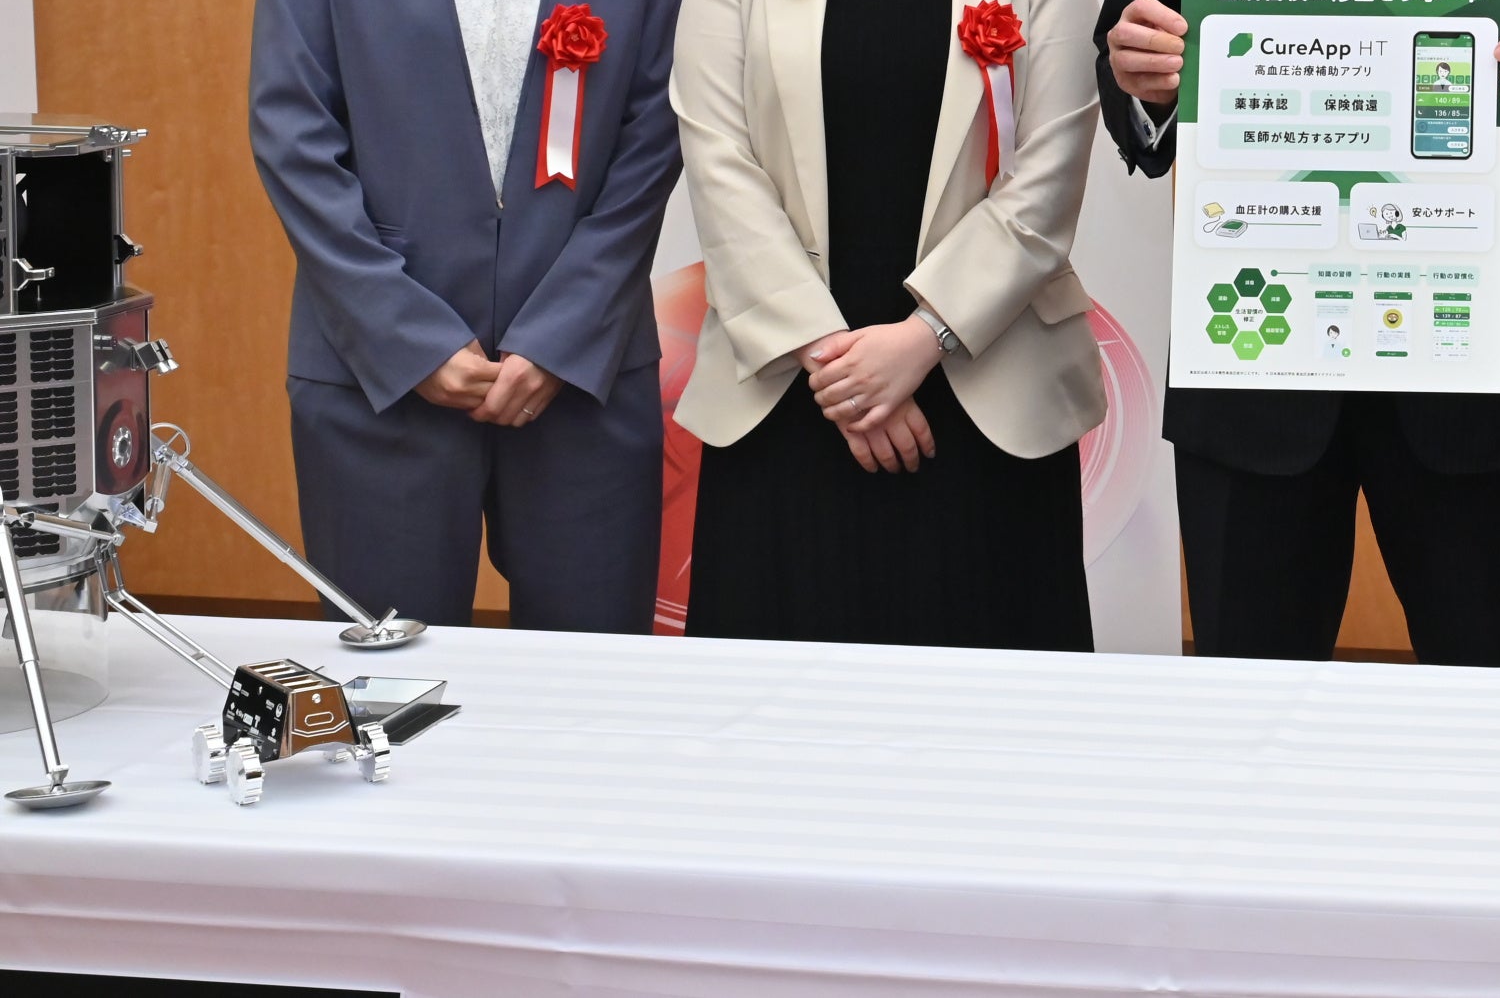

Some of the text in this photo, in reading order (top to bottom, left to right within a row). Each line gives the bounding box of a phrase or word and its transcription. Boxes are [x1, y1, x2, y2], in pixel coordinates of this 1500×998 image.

[1260, 37, 1389, 60] CureApp HT
[1254, 64, 1373, 78] 高血圧治療補助アプリ
[1234, 97, 1289, 111] 薬事承認
[1324, 98, 1379, 112] 保険償還
[1243, 130, 1371, 145] 医師が処方するアプリ
[1235, 204, 1323, 217] 血圧計の購入支援
[1412, 207, 1477, 219] 安心サポート
[1318, 270, 1352, 278] 知識の習得
[1376, 271, 1411, 279] 行動の実践
[1433, 272, 1475, 280] 行動の習慣化
